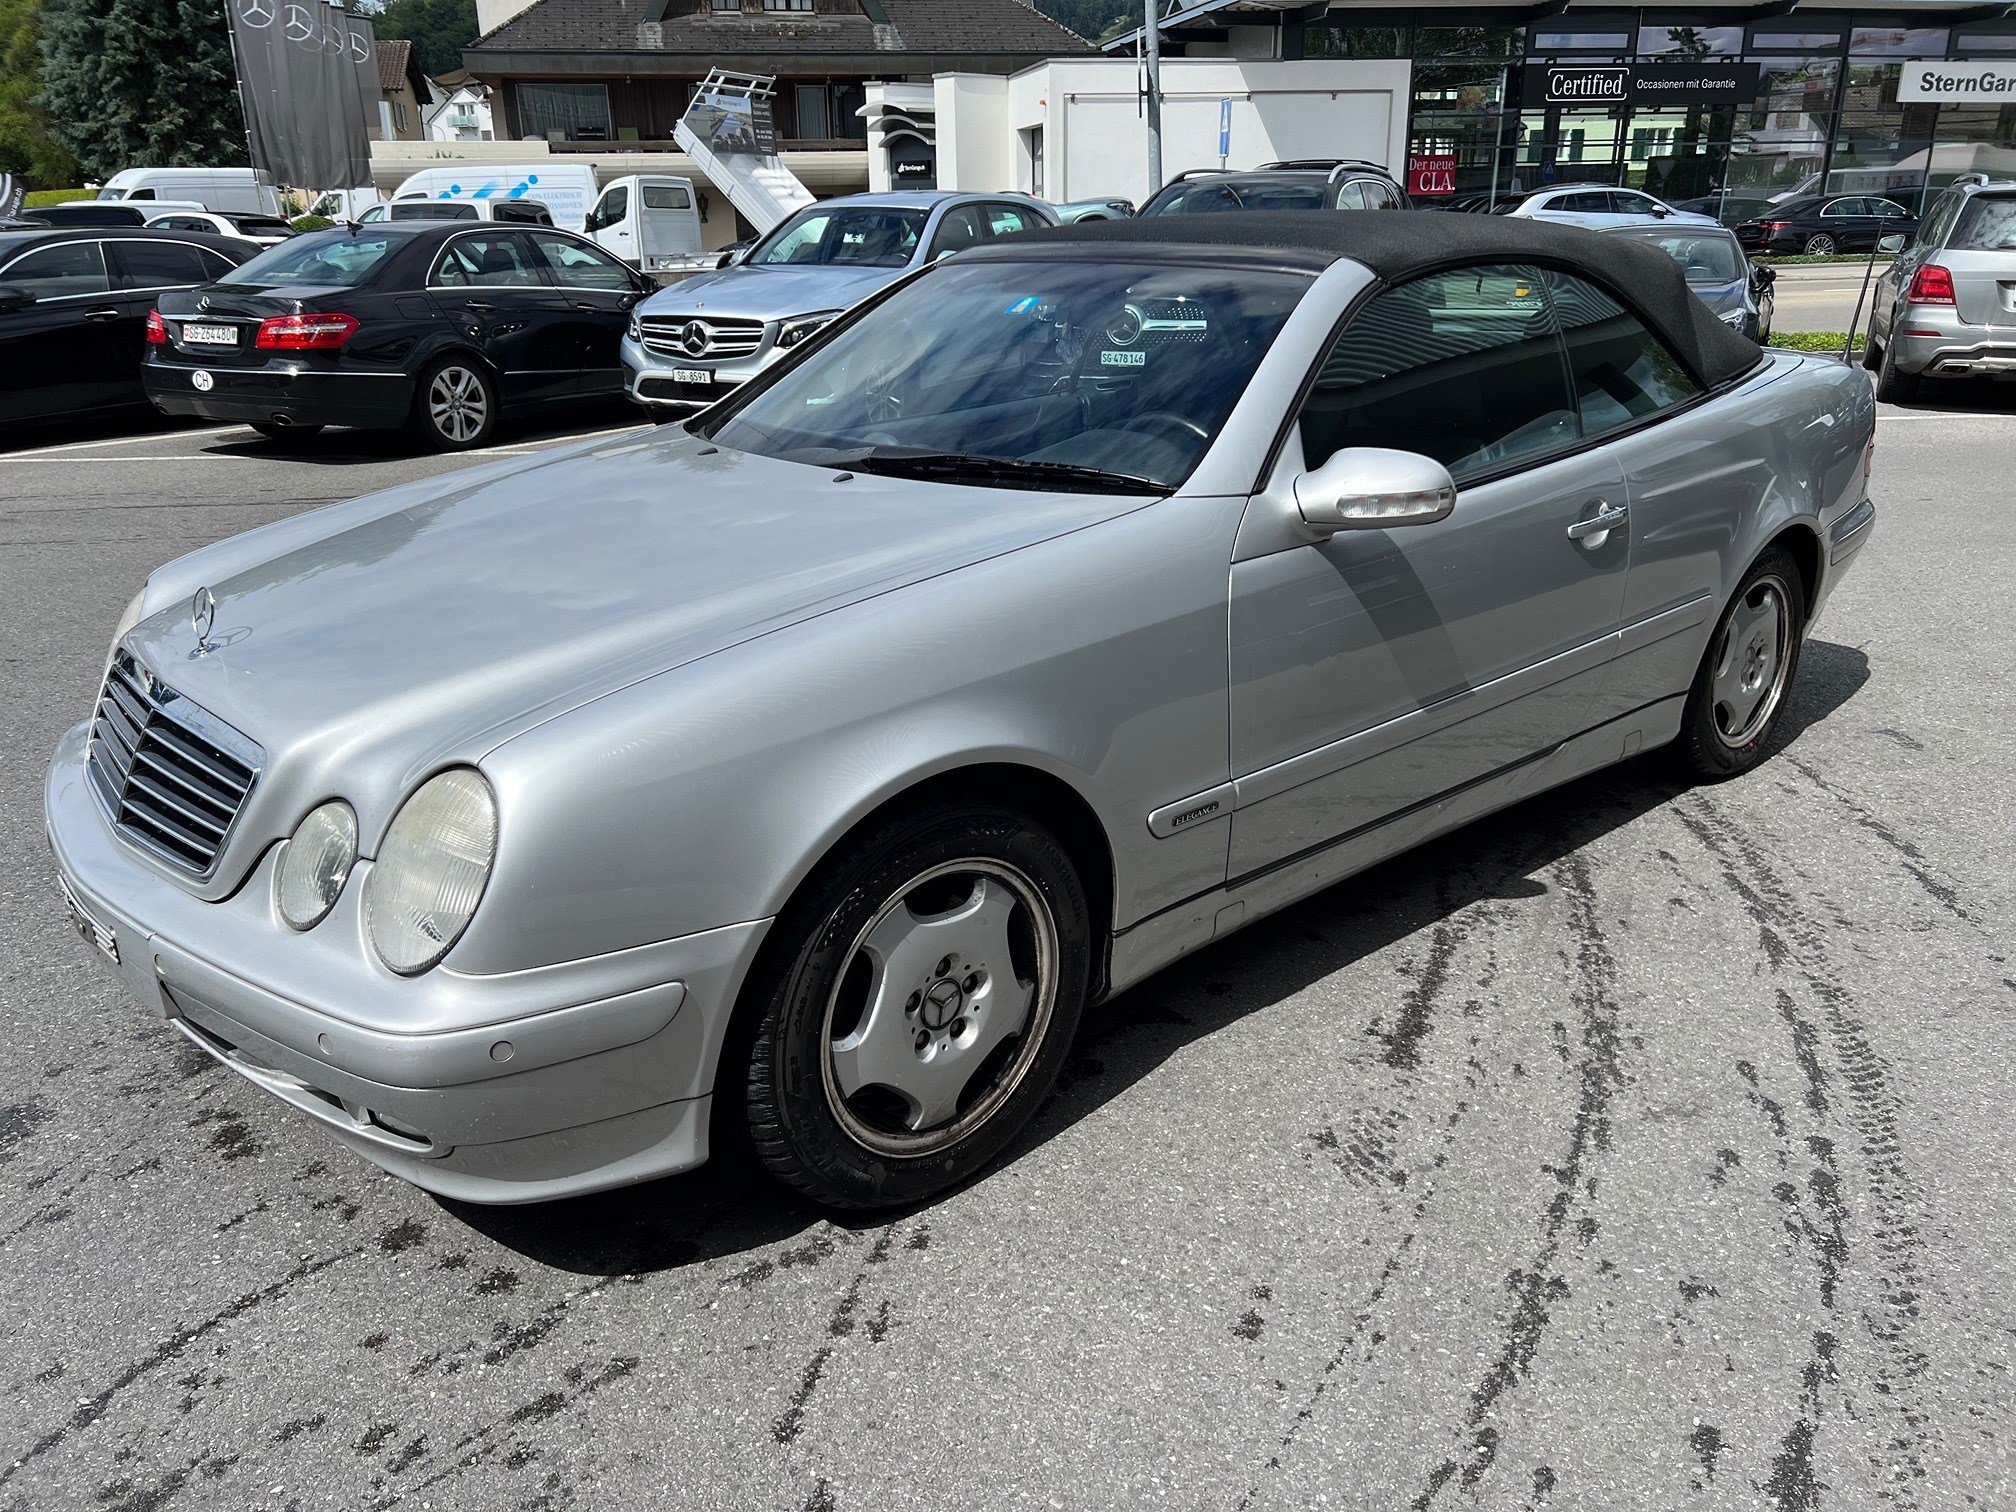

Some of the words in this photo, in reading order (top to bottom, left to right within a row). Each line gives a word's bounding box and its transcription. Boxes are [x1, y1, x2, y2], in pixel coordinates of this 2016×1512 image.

[1551, 73, 1623, 95] Certified
[1636, 79, 1684, 89] Occasionen
[1686, 79, 1700, 89] mit
[1701, 78, 1736, 89] Garantie
[1409, 158, 1428, 171] Der
[1429, 160, 1455, 171] neue
[1419, 171, 1456, 191] CLA.
[196, 373, 210, 388] CH
[1175, 804, 1218, 826] ELEGANCE
